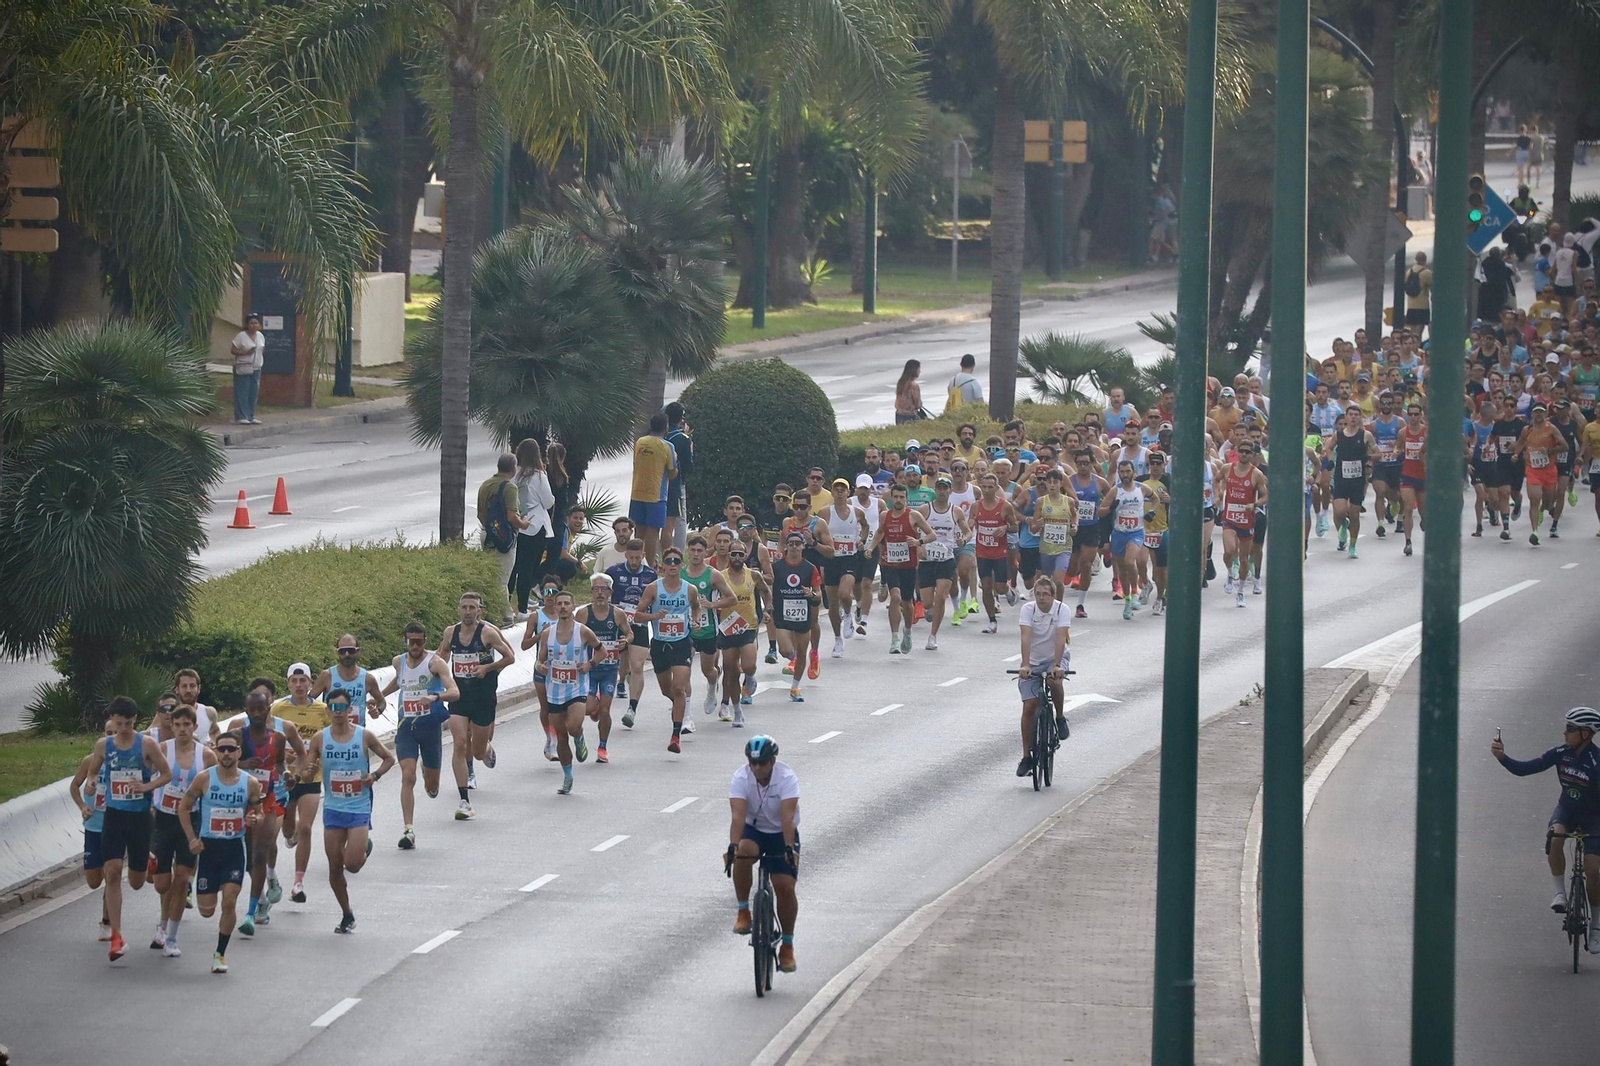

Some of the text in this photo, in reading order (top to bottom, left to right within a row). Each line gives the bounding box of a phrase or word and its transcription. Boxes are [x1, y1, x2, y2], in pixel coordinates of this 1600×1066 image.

[1045, 532, 1065, 541] 2236
[838, 543, 849, 551] 58
[660, 598, 685, 607] nerja
[785, 608, 806, 616] 6270
[666, 624, 678, 633] 36
[731, 623, 740, 634] 42
[555, 671, 571, 680] 161
[326, 749, 359, 761] nerja
[340, 783, 353, 793] 18
[210, 791, 243, 804] nerja
[220, 821, 234, 831] 13
